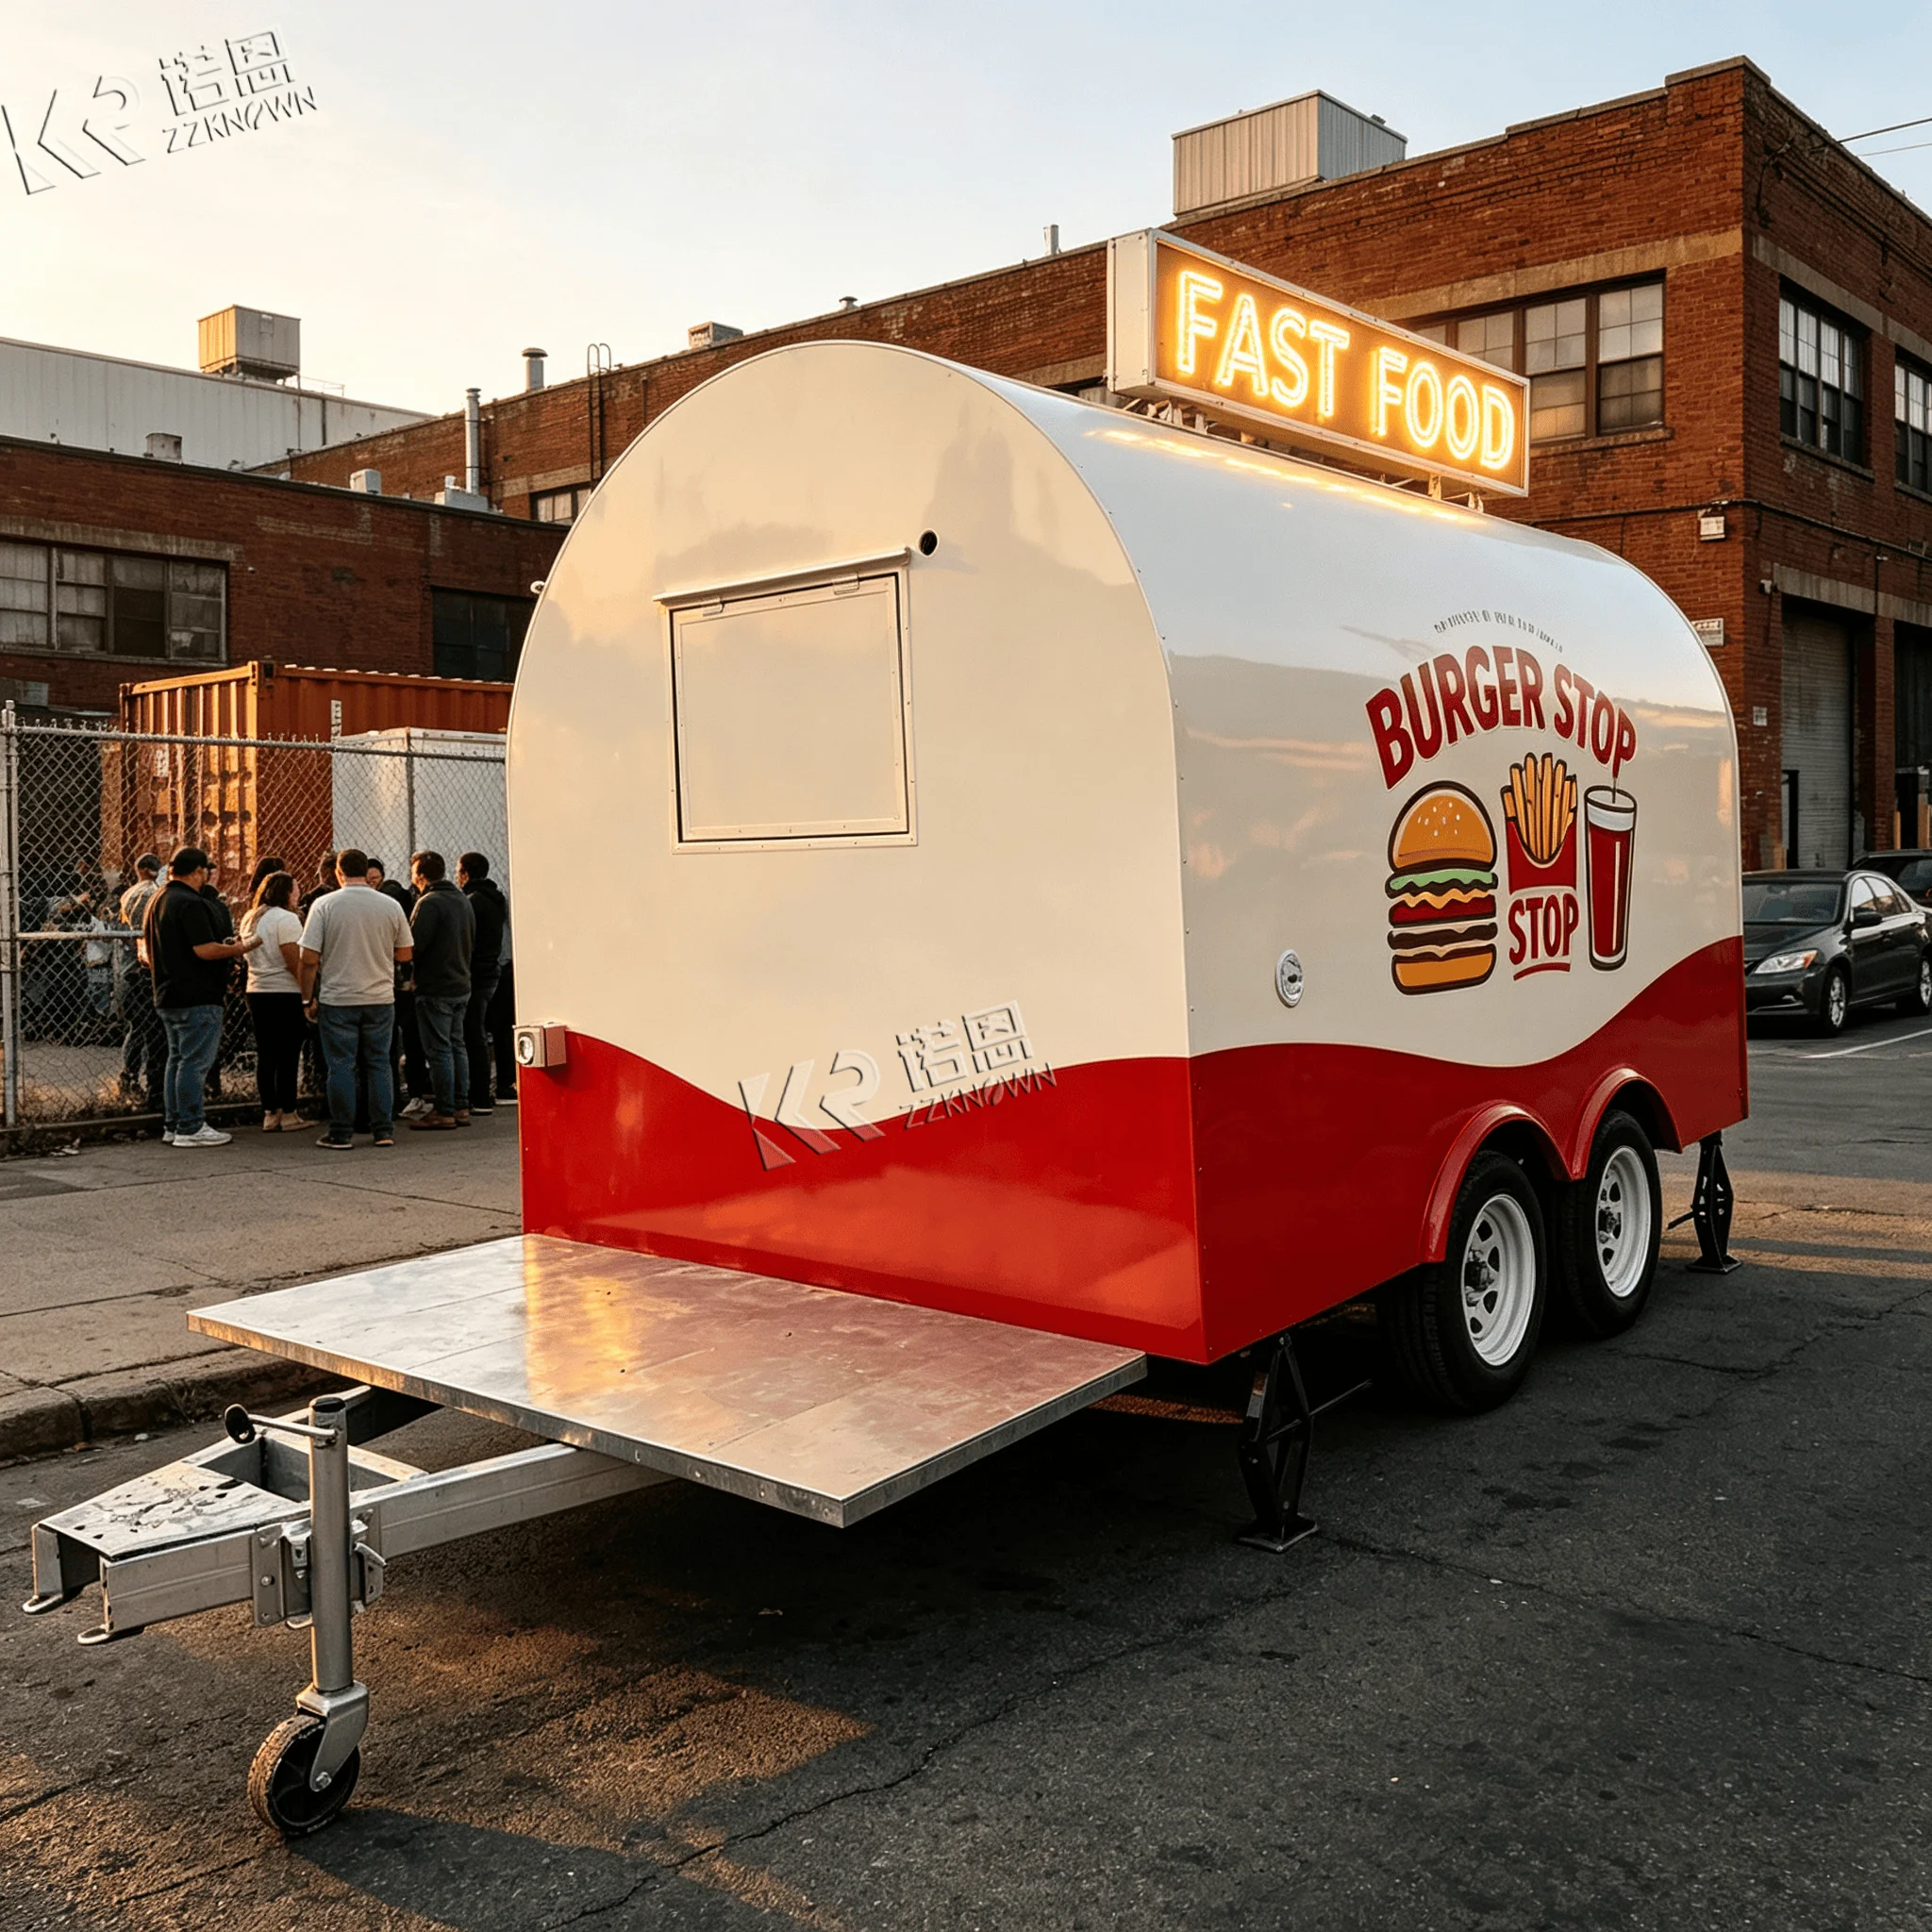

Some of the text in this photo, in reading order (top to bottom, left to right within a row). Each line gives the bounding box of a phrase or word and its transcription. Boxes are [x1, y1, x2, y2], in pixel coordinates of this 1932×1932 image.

[1176, 270, 1514, 470] FAST FOOD
[1365, 645, 1637, 791] BURGER STOP
[1508, 892, 1579, 966] STOP
